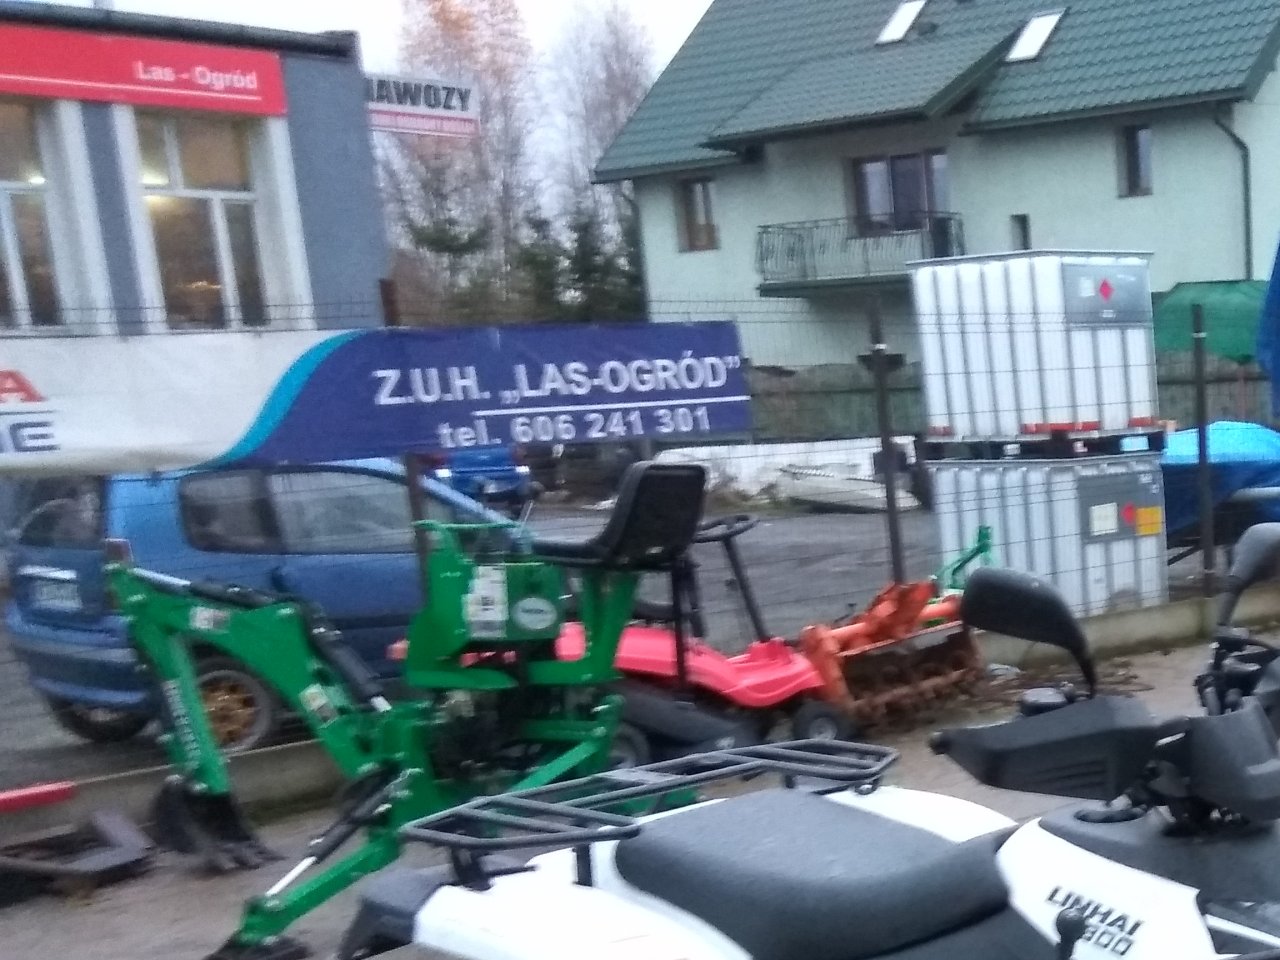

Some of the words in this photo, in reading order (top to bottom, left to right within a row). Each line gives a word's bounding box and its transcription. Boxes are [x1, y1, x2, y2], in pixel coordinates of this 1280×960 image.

[134, 60, 177, 82] Las
[191, 66, 258, 91] Ogród
[372, 365, 491, 406] Z.U.H.
[436, 418, 502, 449] tel.
[510, 414, 577, 443] 606
[584, 410, 645, 438] 241
[654, 406, 711, 434] 301
